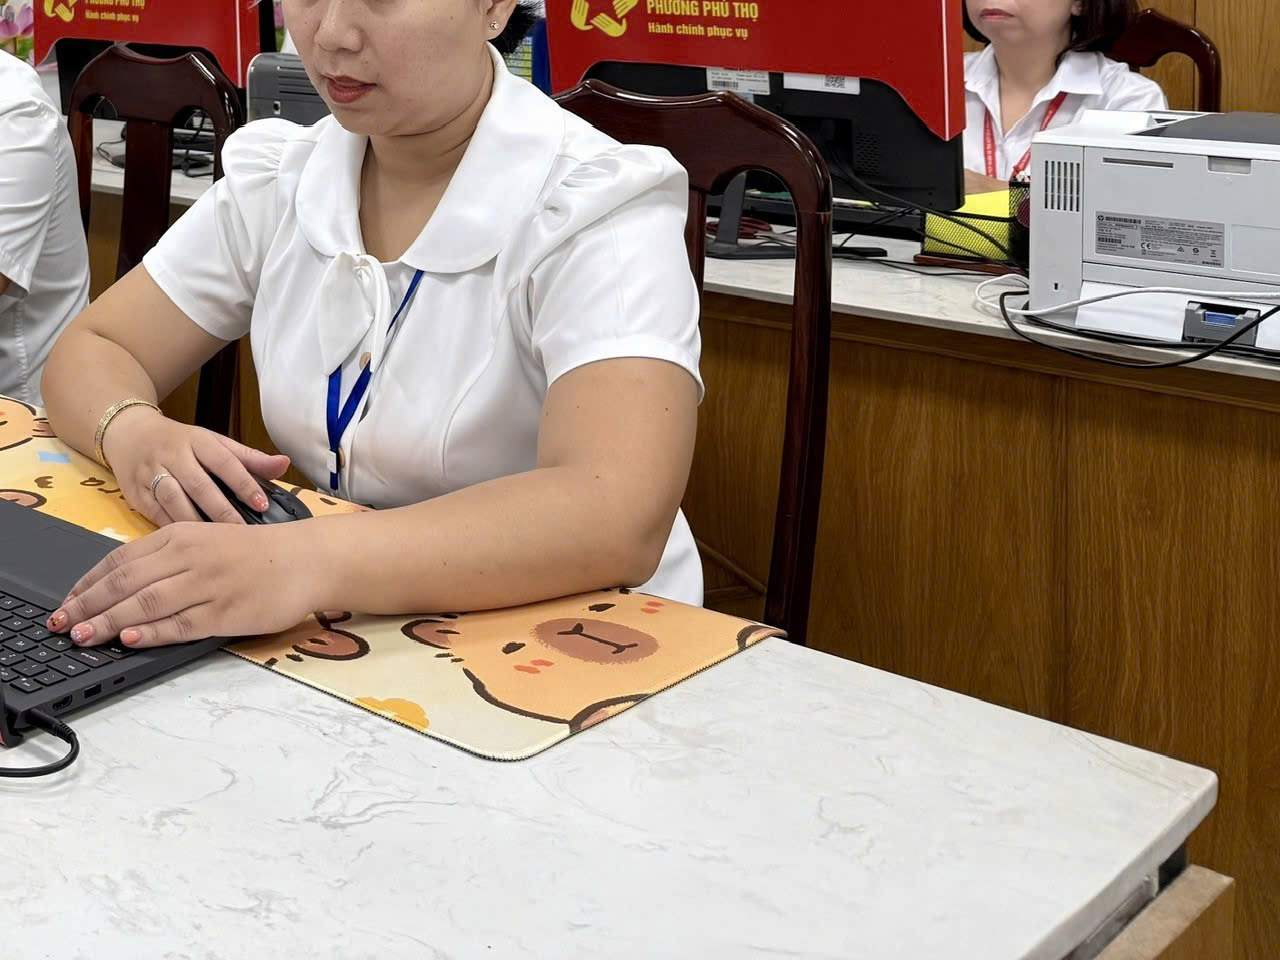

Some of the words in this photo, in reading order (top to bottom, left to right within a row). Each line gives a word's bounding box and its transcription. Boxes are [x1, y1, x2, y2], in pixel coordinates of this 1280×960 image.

[732, 1, 759, 22] THỌ
[648, 22, 673, 35] Hành
[676, 22, 705, 36] chính
[707, 24, 733, 40] phục
[735, 28, 748, 41] vụ
